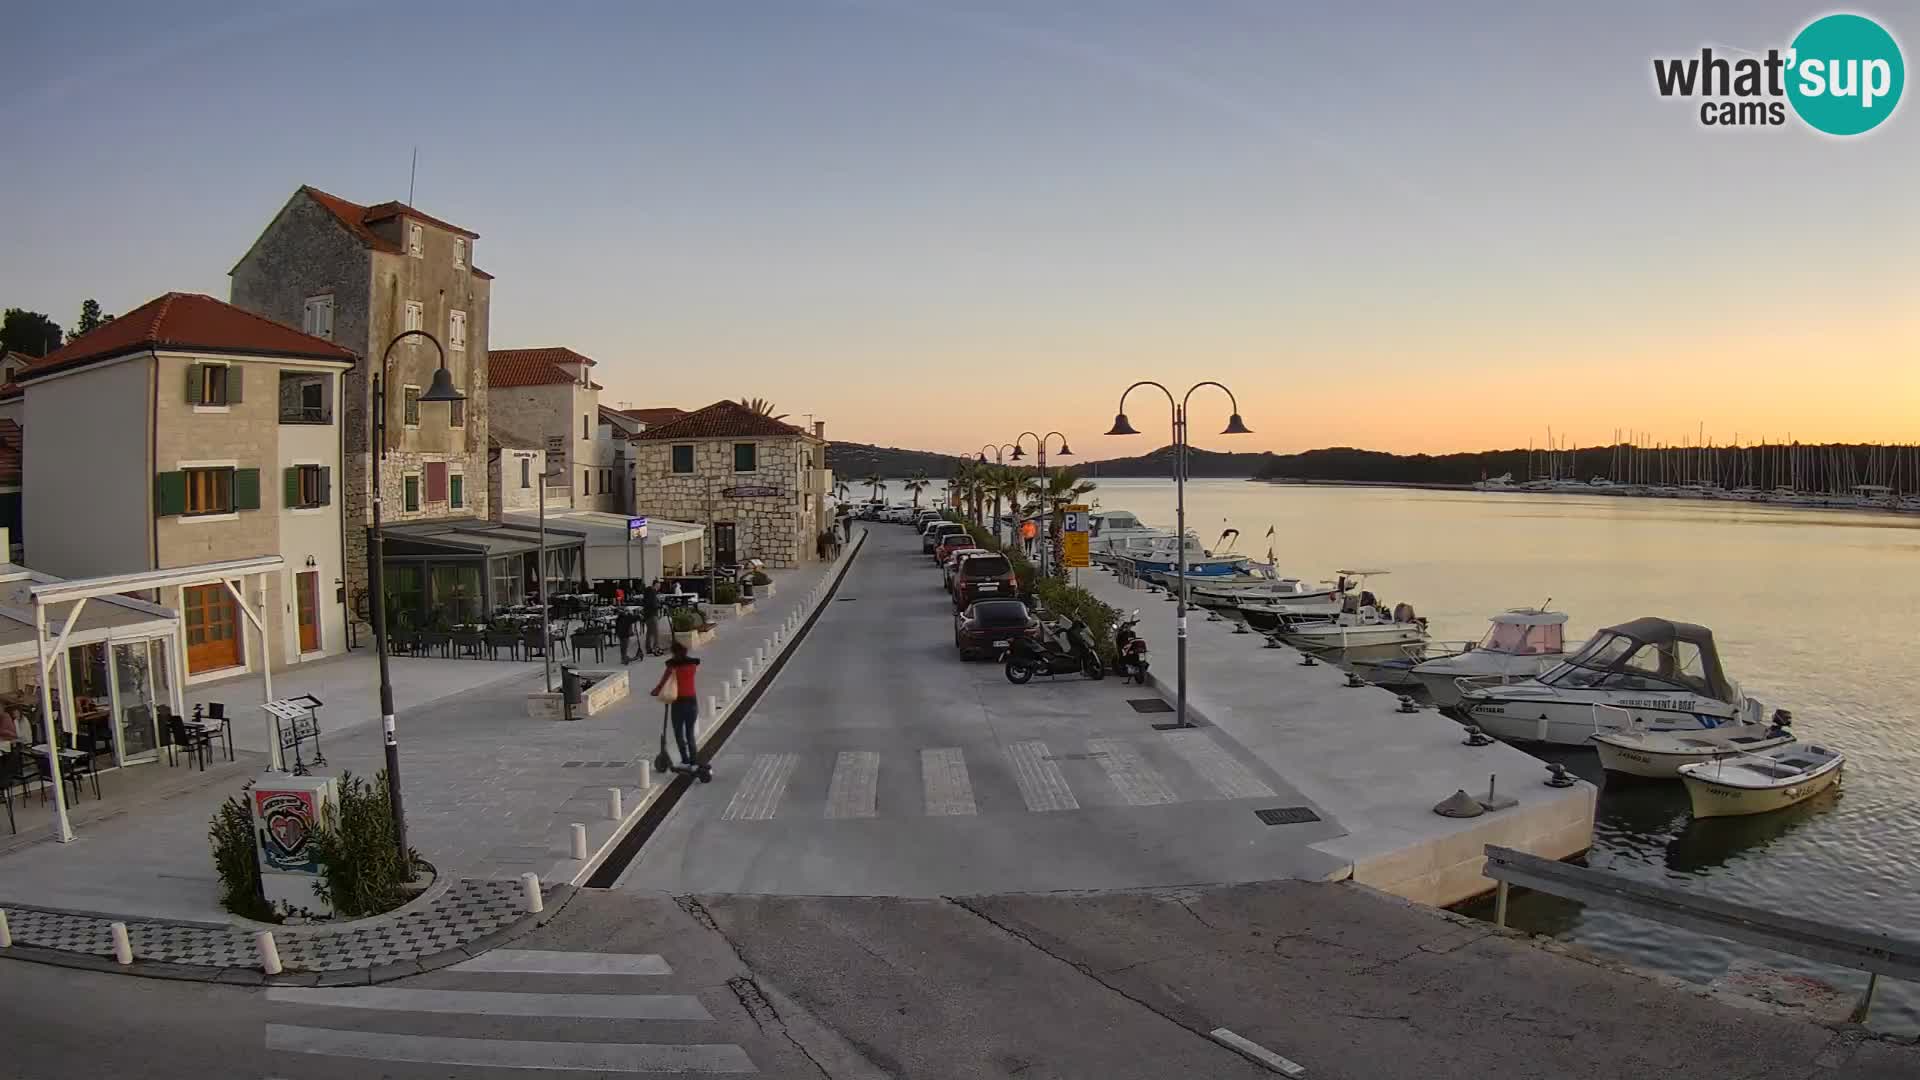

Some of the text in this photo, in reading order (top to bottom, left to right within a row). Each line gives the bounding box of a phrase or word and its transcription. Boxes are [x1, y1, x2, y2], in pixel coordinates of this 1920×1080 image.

[1066, 514, 1076, 530] P
[1653, 699, 1671, 709] RENT
[1672, 699, 1677, 709] A
[1679, 700, 1696, 711] BOAT
